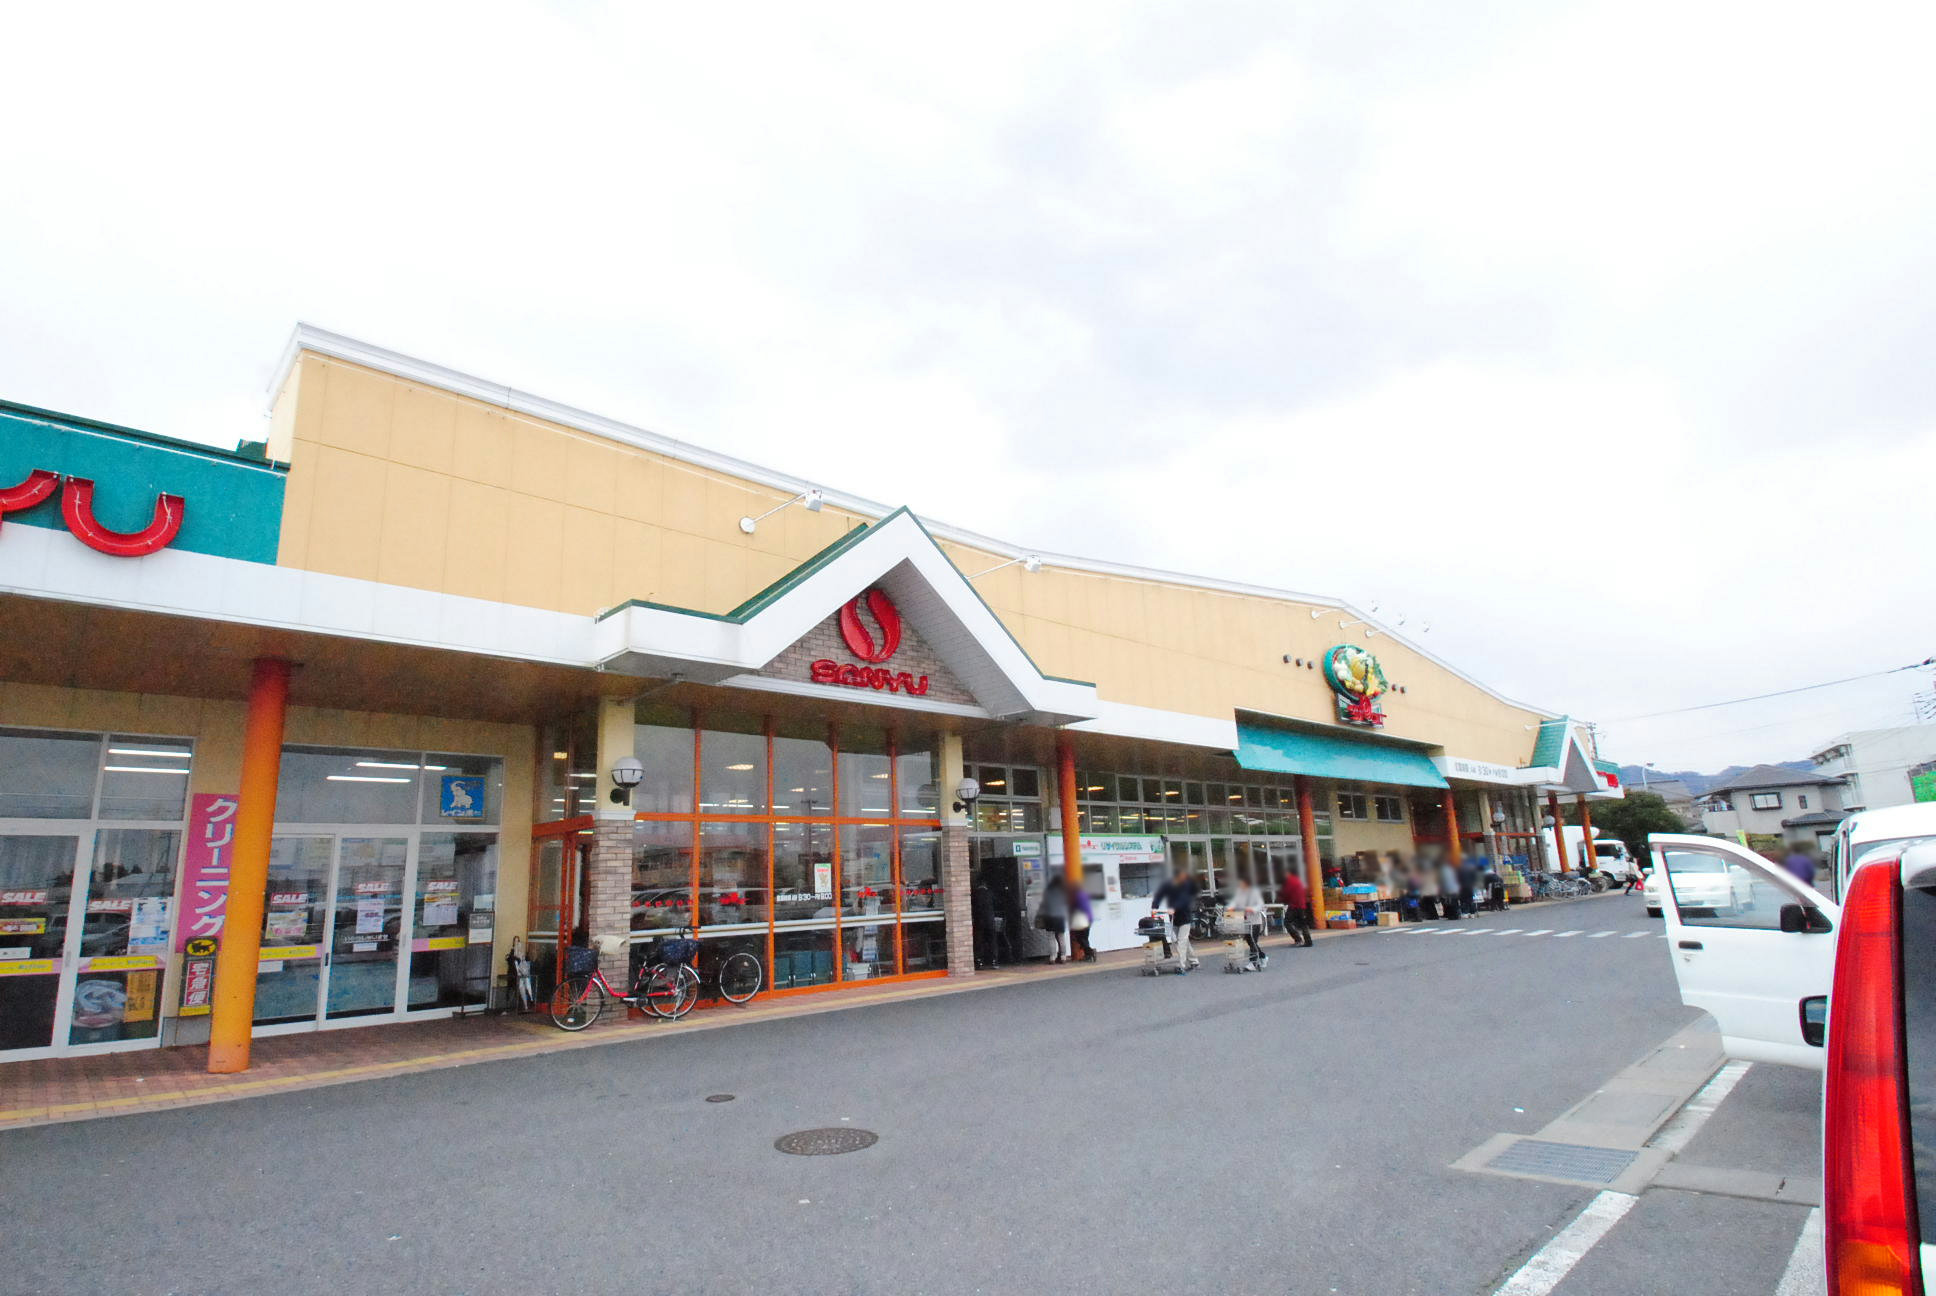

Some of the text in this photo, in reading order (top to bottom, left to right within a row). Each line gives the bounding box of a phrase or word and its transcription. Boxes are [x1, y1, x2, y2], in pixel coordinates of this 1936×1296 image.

[190, 797, 238, 936] クリーニング
[1, 892, 46, 903] SALE
[272, 893, 308, 904] SALE
[89, 900, 131, 911] SALE
[187, 962, 210, 1005] 宅急便
